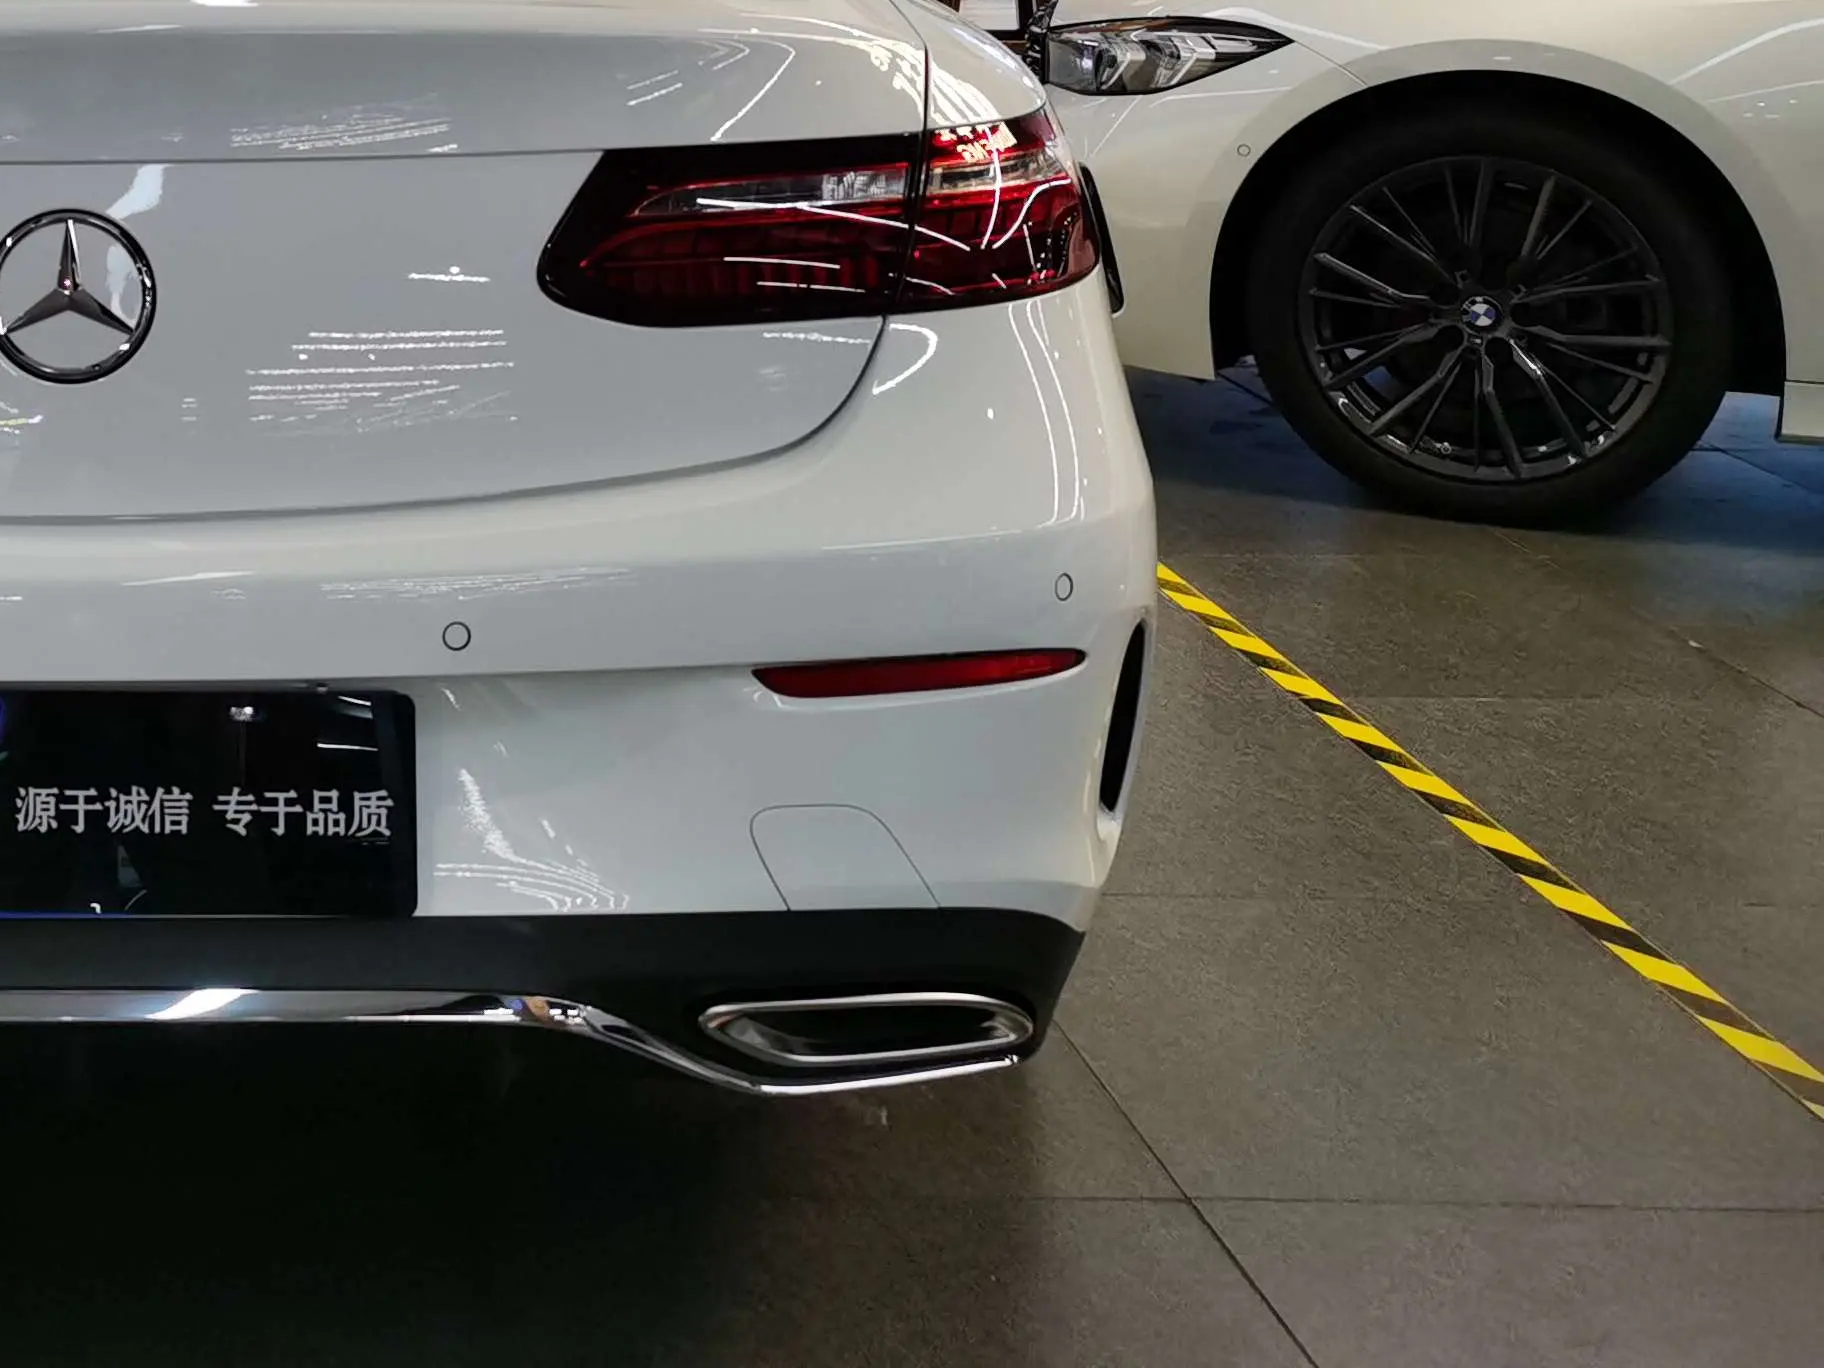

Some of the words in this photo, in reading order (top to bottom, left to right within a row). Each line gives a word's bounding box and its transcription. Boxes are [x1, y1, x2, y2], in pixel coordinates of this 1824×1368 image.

[14, 785, 194, 835] 源于诚信
[211, 786, 395, 837] 专于品质
